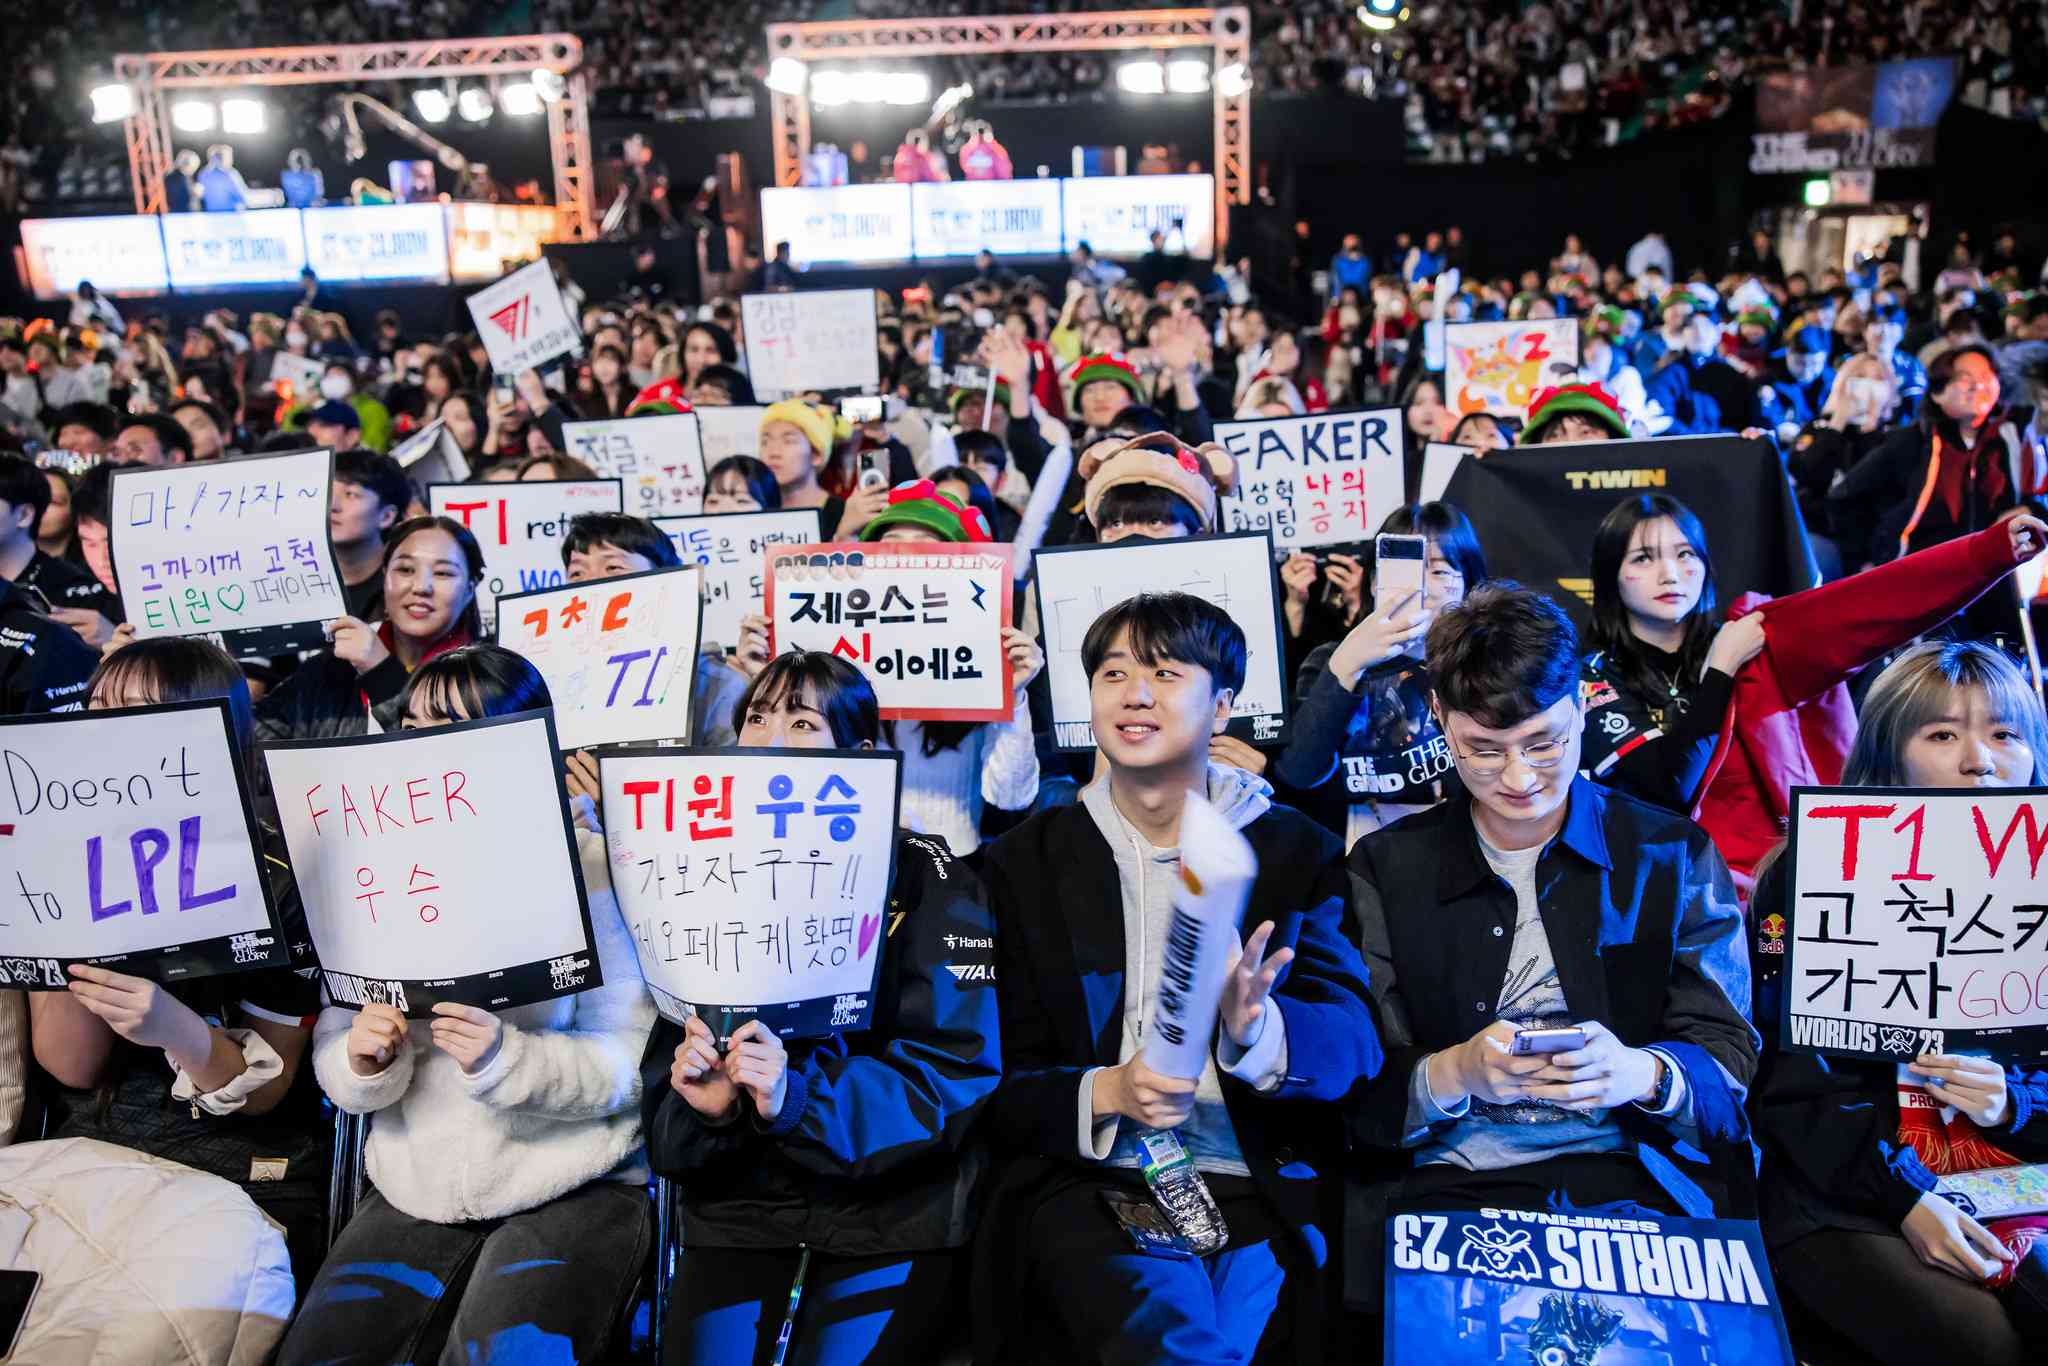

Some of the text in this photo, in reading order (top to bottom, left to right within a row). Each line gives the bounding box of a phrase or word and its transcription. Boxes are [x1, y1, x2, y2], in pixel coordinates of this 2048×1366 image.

[1224, 418, 1392, 470] FAKER
[1305, 467, 1365, 496] 나의
[1565, 469, 1666, 490] T1WIN
[527, 511, 570, 540] ret
[264, 538, 319, 573] 고척
[789, 583, 948, 627] 제우스는
[1402, 735, 1449, 768] THE
[1408, 751, 1456, 785] GLO
[4, 747, 200, 815] Doesn't
[306, 771, 477, 836] FAKER
[756, 774, 862, 842] 우승
[1807, 803, 1935, 880] T1
[87, 815, 236, 923] LPL
[355, 864, 440, 923] 우승
[959, 937, 987, 948] Hana
[37, 958, 67, 986] 23
[553, 974, 585, 990] GLORY
[1805, 958, 1952, 1018] 가자
[1790, 1016, 1944, 1054] WORLDS 23
[1910, 1094, 1937, 1107] PRO
[1480, 1208, 1660, 1233] SEMIFINALS
[1394, 1214, 1769, 1306] WORLDS 23
